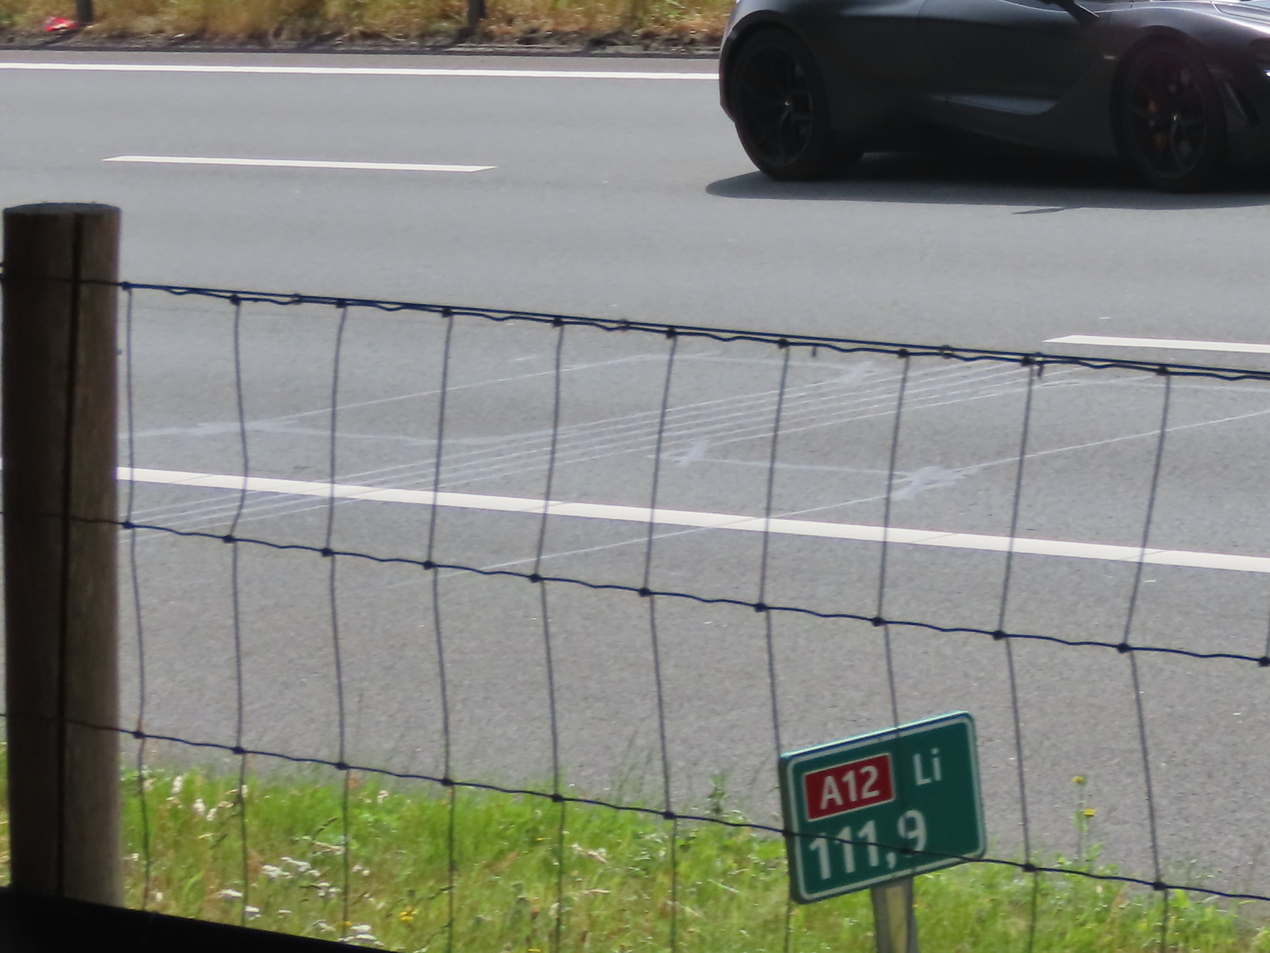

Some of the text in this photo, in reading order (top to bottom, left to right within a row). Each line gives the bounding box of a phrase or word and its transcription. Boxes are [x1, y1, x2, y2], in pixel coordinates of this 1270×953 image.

[820, 748, 943, 809] A12 Li
[809, 809, 927, 880] 111,9
